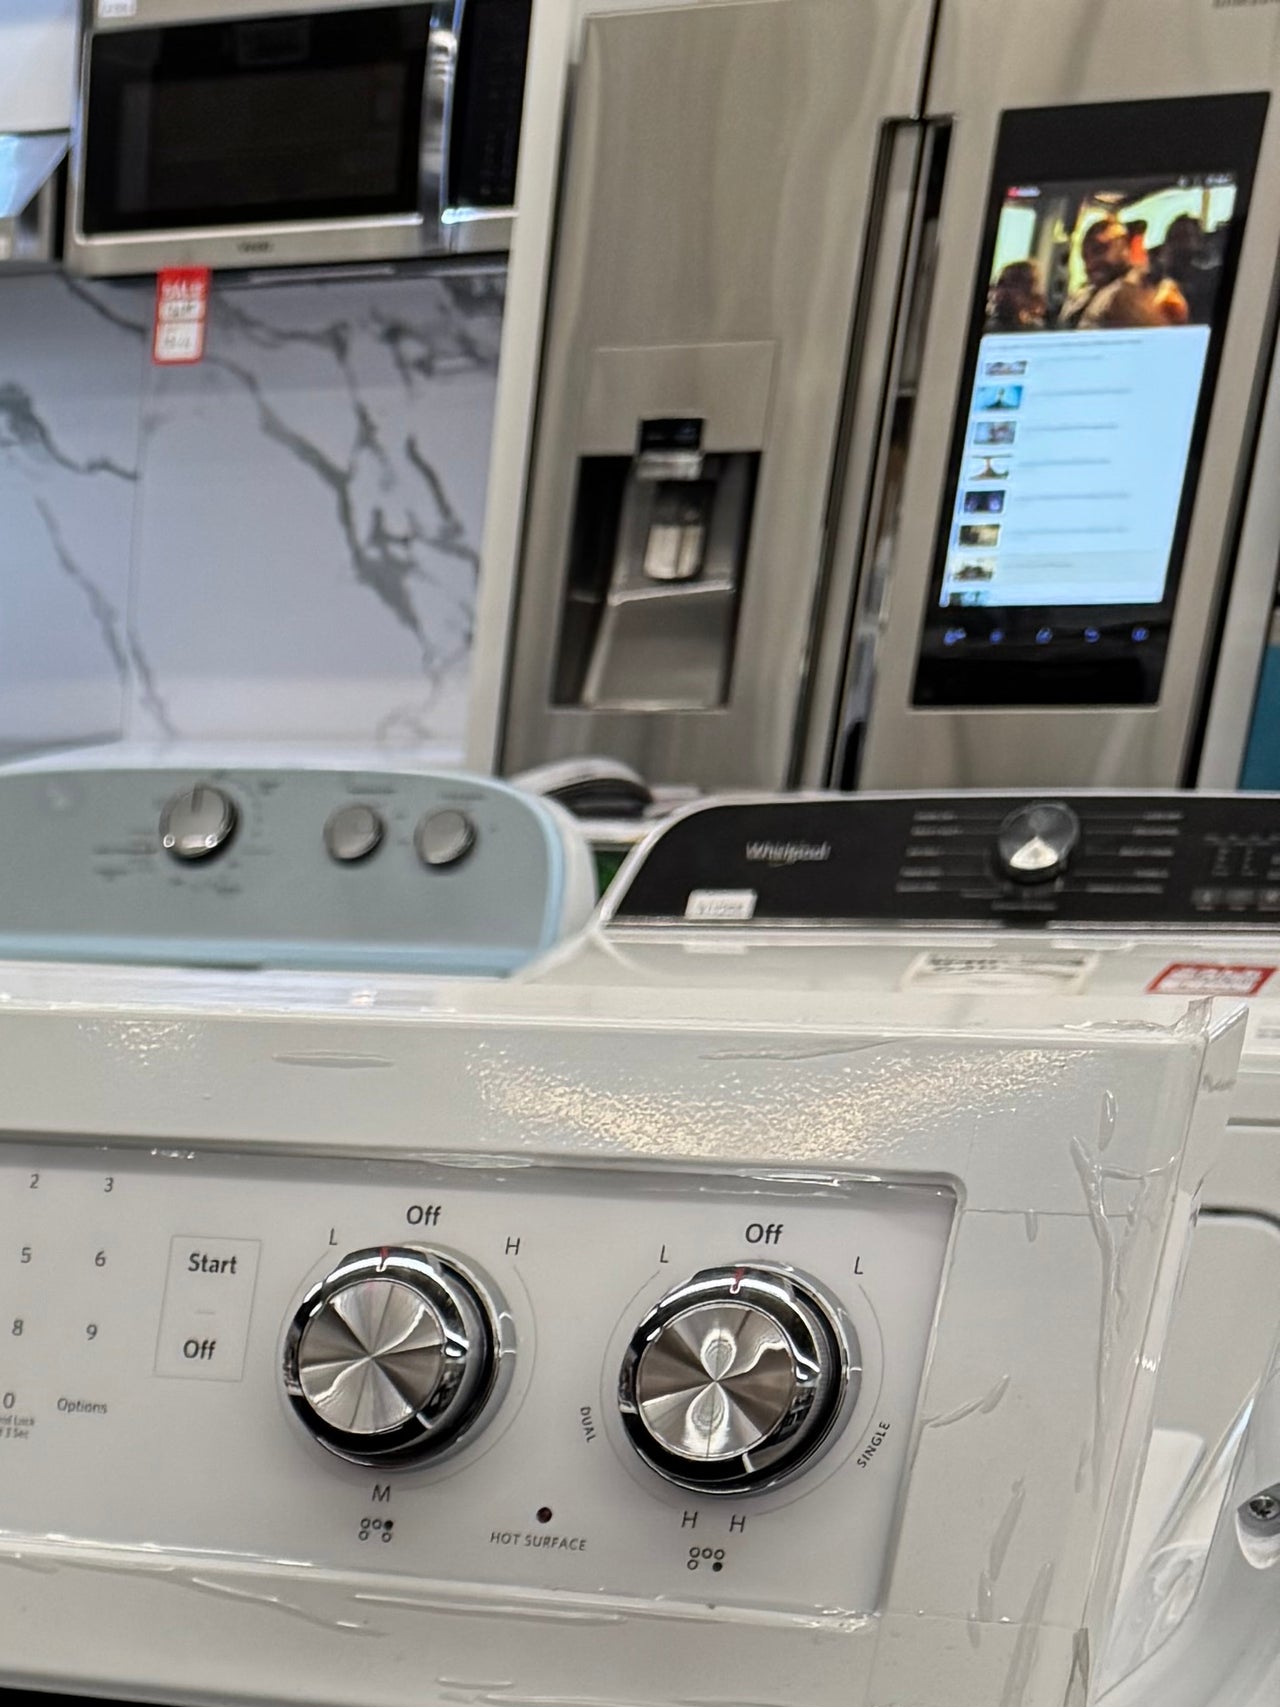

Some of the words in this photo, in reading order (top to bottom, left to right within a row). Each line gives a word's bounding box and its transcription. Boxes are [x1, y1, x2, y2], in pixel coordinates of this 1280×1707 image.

[30, 1173, 40, 1190] 2
[104, 1177, 114, 1193] 3
[406, 1204, 441, 1227] Off
[329, 1228, 338, 1246] L
[745, 1223, 784, 1246] Off
[21, 1247, 32, 1264] 5
[505, 1237, 521, 1256] H
[660, 1245, 670, 1264] L
[95, 1251, 106, 1268] 6
[187, 1252, 238, 1275] Start
[854, 1256, 864, 1276] L
[12, 1318, 24, 1336] 8
[87, 1323, 98, 1341] 9
[183, 1338, 217, 1361] Off
[3, 1392, 15, 1410] 0
[57, 1397, 108, 1415] Options
[579, 1407, 597, 1443] DUAL
[857, 1421, 891, 1468] SINGLE
[372, 1485, 391, 1503] M
[681, 1511, 698, 1530] H
[729, 1516, 746, 1534] H
[490, 1531, 521, 1546] HOT
[524, 1534, 587, 1551] SURFACE
